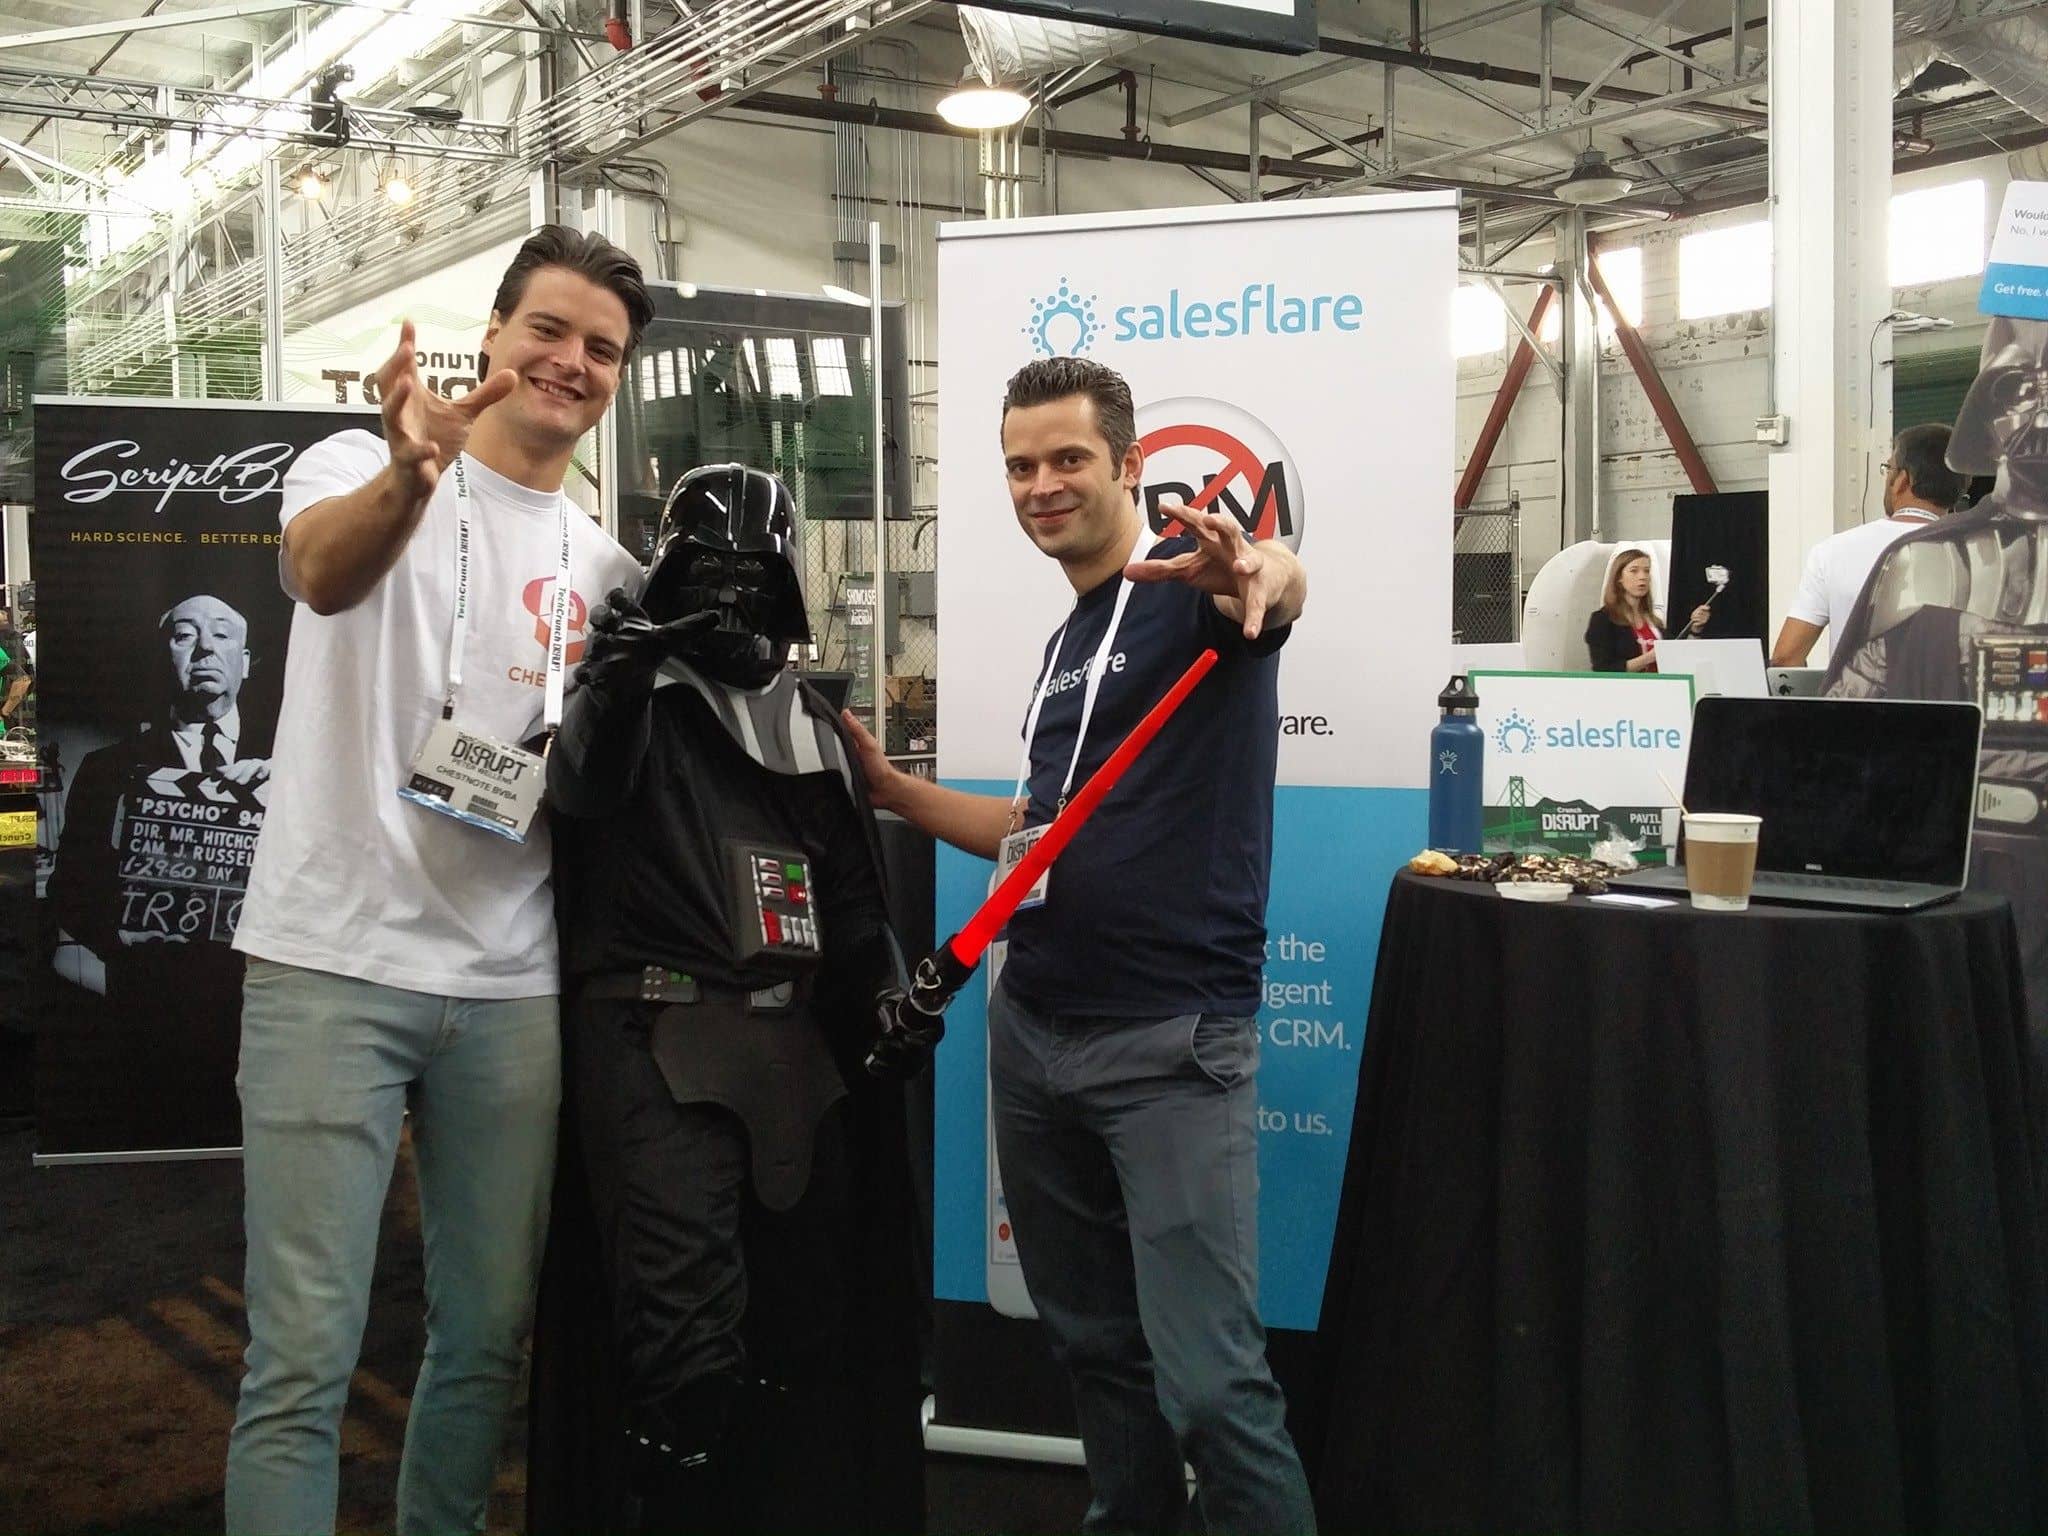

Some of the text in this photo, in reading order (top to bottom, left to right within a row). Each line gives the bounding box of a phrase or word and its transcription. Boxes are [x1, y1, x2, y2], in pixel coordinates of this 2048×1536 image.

[1994, 282, 2015, 295] Get
[1114, 283, 1363, 342] salesflare
[71, 532, 113, 543] HARD
[117, 532, 187, 544] SCIENCE.
[201, 533, 258, 545] BETTER
[1279, 715, 1334, 736] are.
[1546, 719, 1681, 749] salesflare
[450, 738, 529, 781] DISRUPT
[1541, 813, 1600, 831] DISRUPT
[169, 826, 198, 844] MR.
[207, 866, 234, 882] DAY
[1278, 933, 1326, 962] the
[1269, 1018, 1352, 1050] CRM.
[1294, 1111, 1333, 1136] us.
